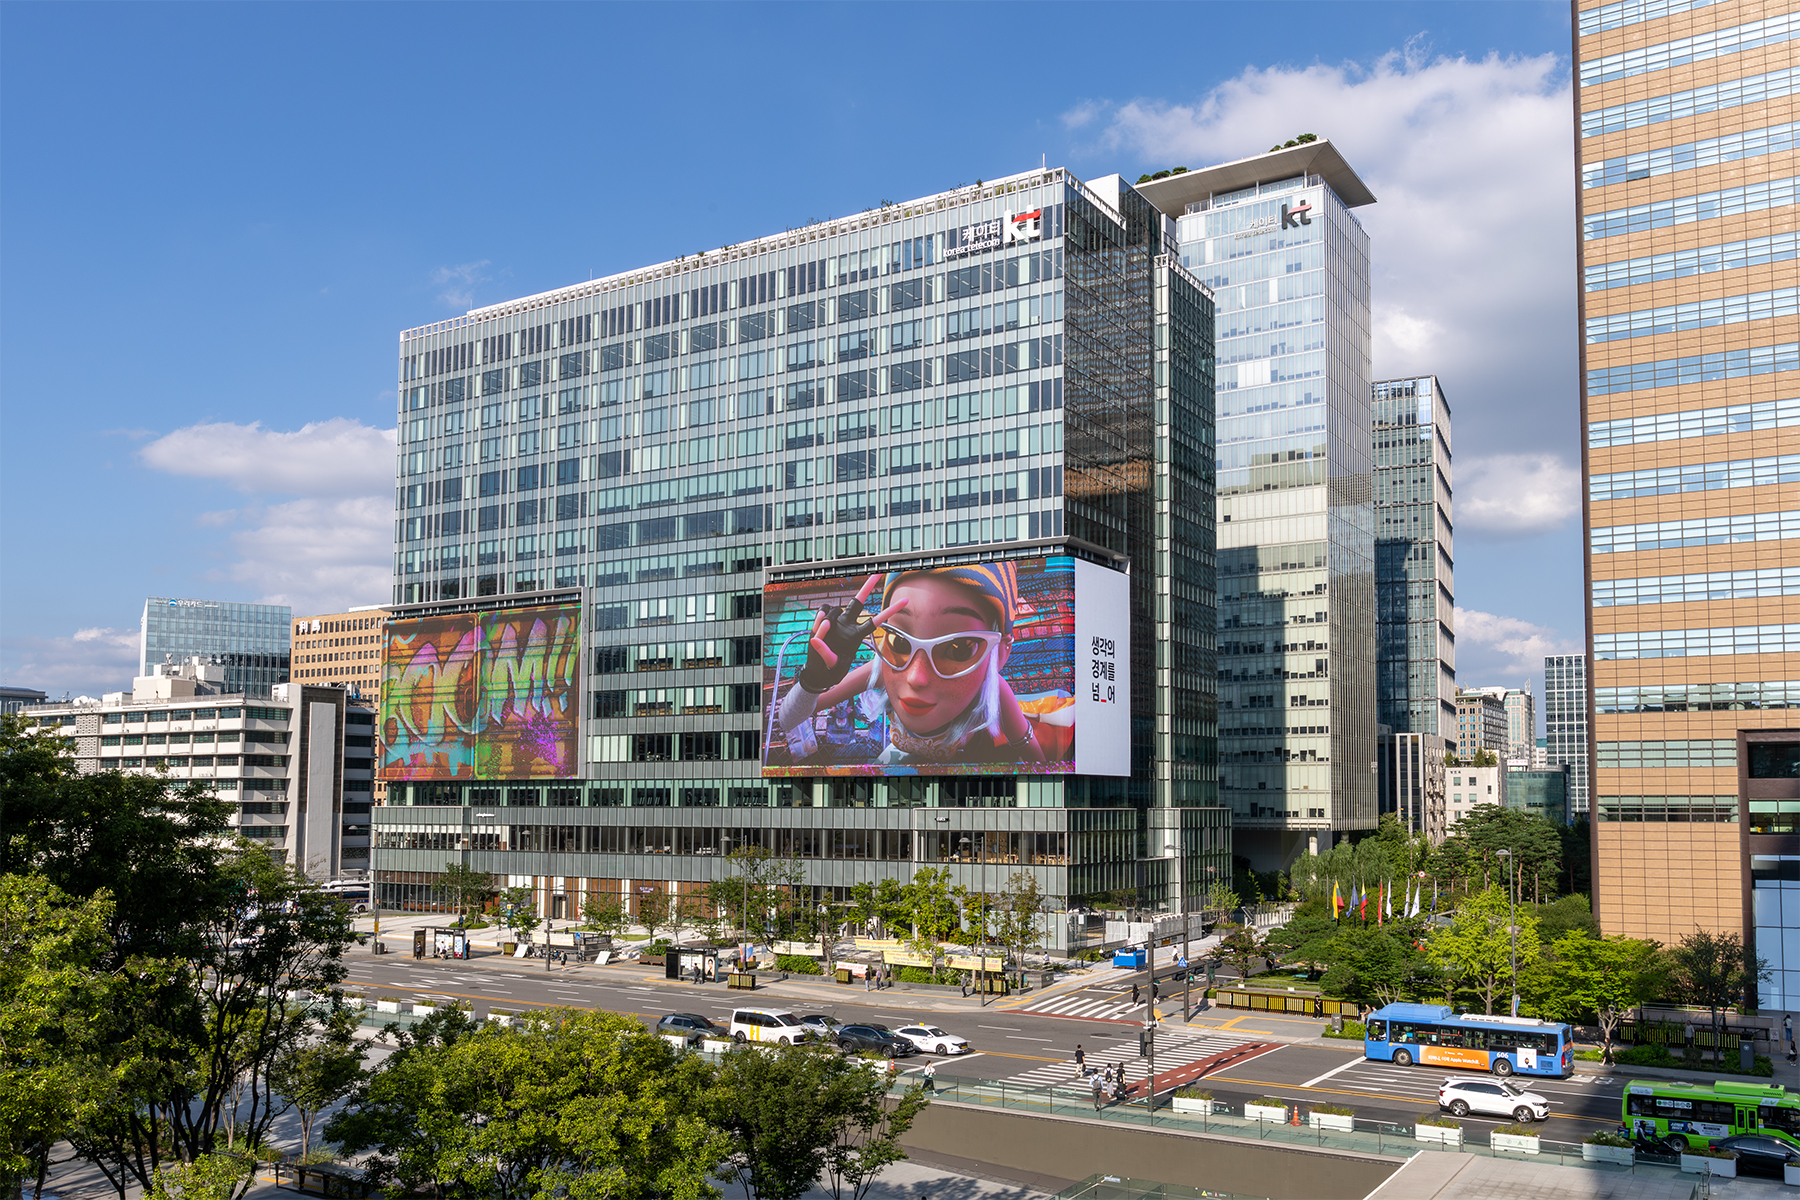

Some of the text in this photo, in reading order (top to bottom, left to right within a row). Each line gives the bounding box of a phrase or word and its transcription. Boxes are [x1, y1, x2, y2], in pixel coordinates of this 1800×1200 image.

[1003, 204, 1041, 244] kt
[1249, 214, 1278, 229] 케이티
[1281, 199, 1312, 230] kt
[962, 220, 1001, 242] 케이티
[943, 237, 1000, 258] korea telecom
[1091, 636, 1115, 659] 생각의
[1091, 659, 1116, 682] 경계를
